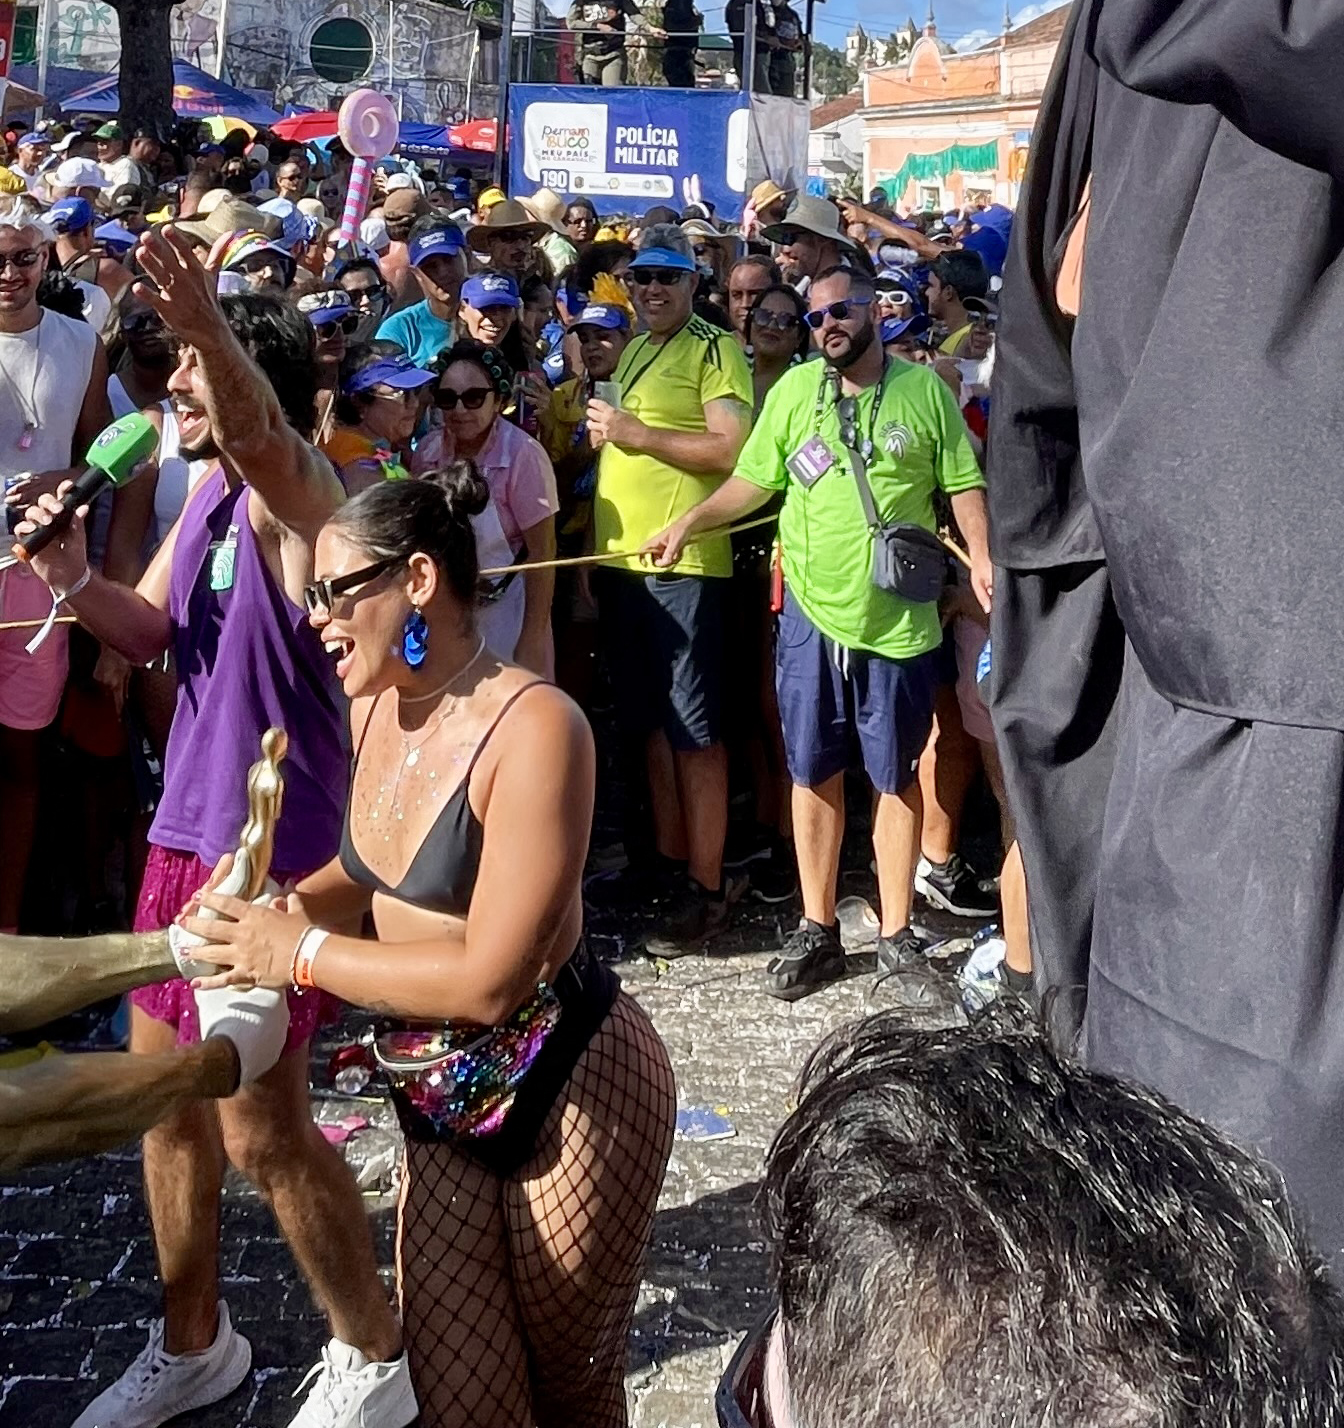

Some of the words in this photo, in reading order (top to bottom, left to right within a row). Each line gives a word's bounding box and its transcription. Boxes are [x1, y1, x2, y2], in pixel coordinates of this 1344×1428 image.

[615, 123, 679, 147] POLÍCIA
[615, 146, 679, 167] MILITAR
[541, 170, 568, 188] 190
